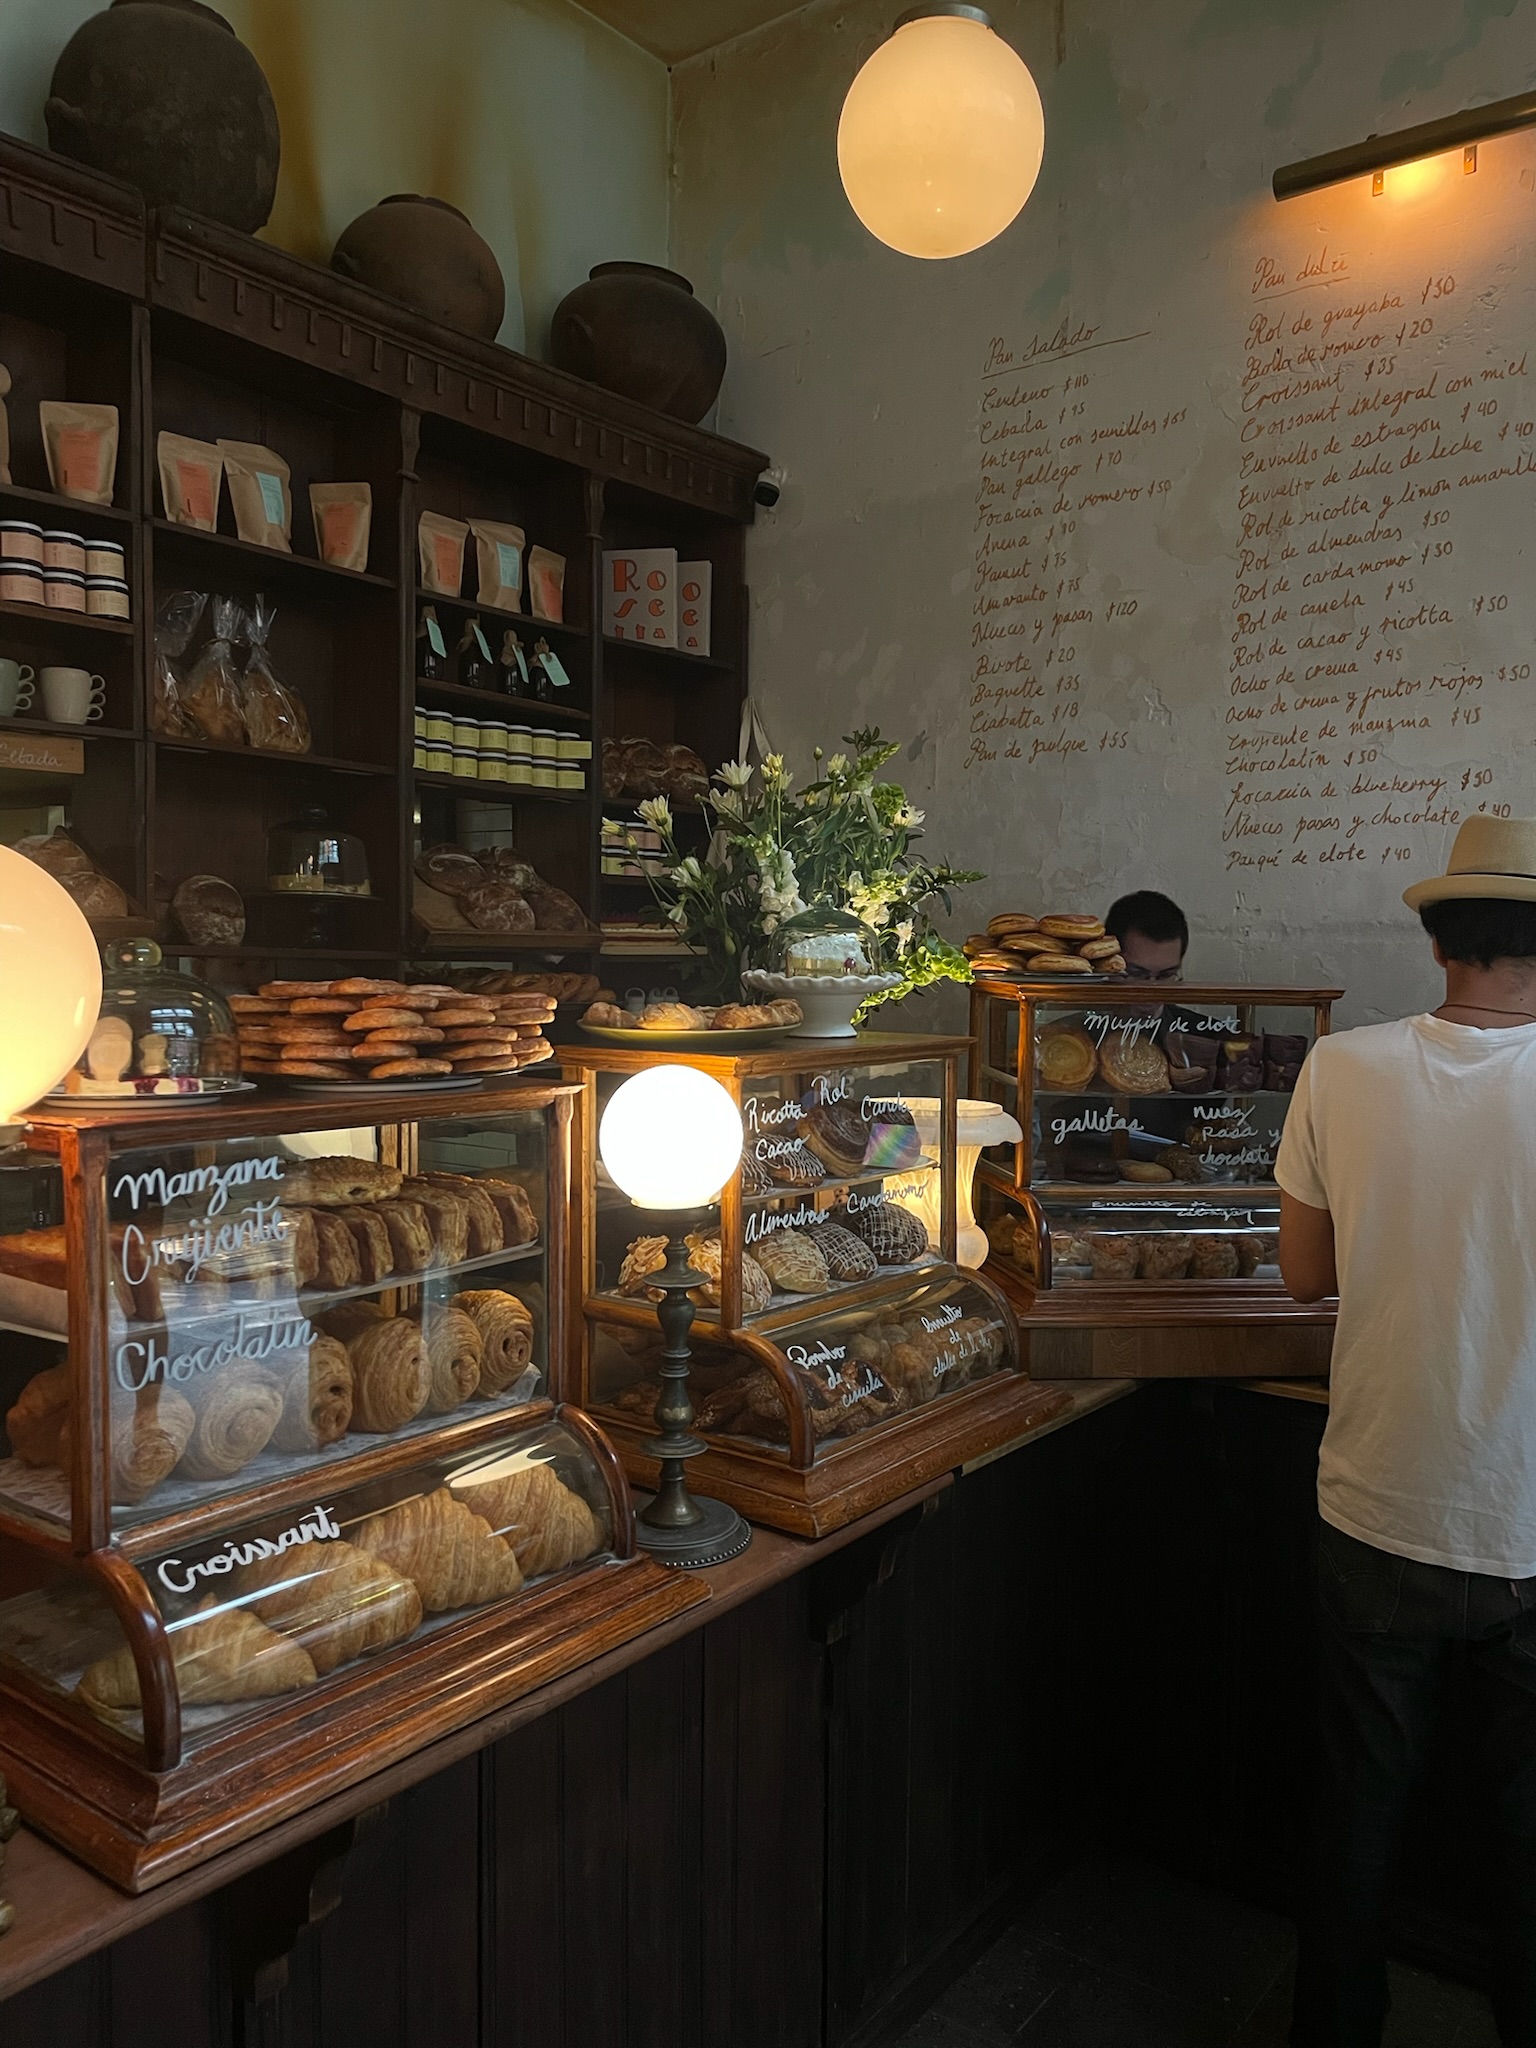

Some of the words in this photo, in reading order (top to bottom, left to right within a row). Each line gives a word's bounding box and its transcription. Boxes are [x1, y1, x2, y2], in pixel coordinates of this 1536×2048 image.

[1252, 257, 1285, 294] Pan
[1245, 311, 1286, 350] Rol
[1292, 310, 1313, 335] de
[1322, 293, 1404, 339] guayaba
[984, 337, 1013, 372] Pan
[1023, 322, 1100, 361] Salado
[1297, 345, 1314, 365] de
[982, 386, 1054, 412] Centeno
[1241, 396, 1340, 443] Croissant
[1348, 372, 1437, 417] integral
[1445, 374, 1473, 394] con
[1481, 352, 1528, 381] miel
[1242, 367, 1345, 412] Croissant
[980, 411, 1047, 443] Cebada
[1060, 435, 1082, 449] con
[1091, 411, 1156, 443] semillas
[1238, 480, 1315, 510] Envuelto
[1323, 465, 1341, 485] de
[1349, 453, 1394, 480] dulce
[1400, 445, 1422, 470] de
[1427, 433, 1483, 461] leche
[1240, 441, 1317, 479] Envuelto
[1324, 435, 1341, 454] de
[976, 476, 1005, 503] Pan
[1013, 461, 1082, 499] gallego
[1053, 494, 1072, 513] de
[1079, 487, 1143, 509] romero
[1237, 511, 1274, 548] Rol
[1279, 512, 1294, 528] de
[1299, 495, 1371, 525] ricotta
[1379, 494, 1395, 519] y
[1236, 549, 1270, 579] Rol
[1281, 542, 1298, 561] de
[1308, 520, 1402, 554] almendras
[973, 584, 1048, 616] Amaranto
[1232, 579, 1268, 610] Rol
[1272, 576, 1291, 595] de
[1303, 554, 1412, 588] cardamomo
[1033, 619, 1043, 644] y
[1051, 608, 1093, 637] pasas
[1232, 609, 1266, 643] Rol
[1272, 606, 1287, 624] de
[1300, 590, 1366, 616] canela
[1230, 642, 1262, 673] Rol
[1269, 638, 1287, 655] de
[1298, 631, 1352, 650] cacao
[1356, 625, 1370, 650] y
[1378, 604, 1453, 634] ricotta
[970, 677, 1045, 707] Baguette
[1226, 705, 1264, 724] Ocho
[1270, 693, 1287, 715] de
[1294, 696, 1340, 710] crema
[1346, 691, 1357, 714] y
[1359, 679, 1421, 720] frutos
[1429, 667, 1484, 700] rojos
[1231, 674, 1270, 696] Ocho
[1276, 666, 1295, 684] de
[1305, 662, 1359, 681] crema
[970, 704, 1044, 733] Ciabatta
[1318, 720, 1338, 739] de
[964, 738, 996, 769] Pan
[1005, 742, 1022, 758] de
[1029, 728, 1088, 764] pulque
[1320, 782, 1338, 798] de
[1352, 774, 1446, 801] blueberry
[1222, 810, 1284, 841] Nueces
[1293, 816, 1340, 843] pasas
[1346, 816, 1364, 838] y
[1371, 802, 1460, 826] chocolate
[1292, 850, 1307, 864] de
[1319, 844, 1367, 862] elote
[1169, 1016, 1189, 1032] de
[1196, 1016, 1241, 1034] elote
[811, 1075, 849, 1106] Rol
[744, 1097, 807, 1133] Ricotta
[1050, 1107, 1144, 1144] galletas
[756, 1134, 810, 1161] Cacao
[1199, 1145, 1275, 1165] chocolate
[1268, 1127, 1281, 1146] y
[113, 1155, 285, 1216] Manzana
[123, 1196, 288, 1284] Crujiente
[744, 1203, 829, 1244] Almendras
[949, 1328, 961, 1344] de
[787, 1341, 846, 1370] Rombo
[827, 1364, 842, 1389] de
[158, 1506, 340, 1593] Croissant
